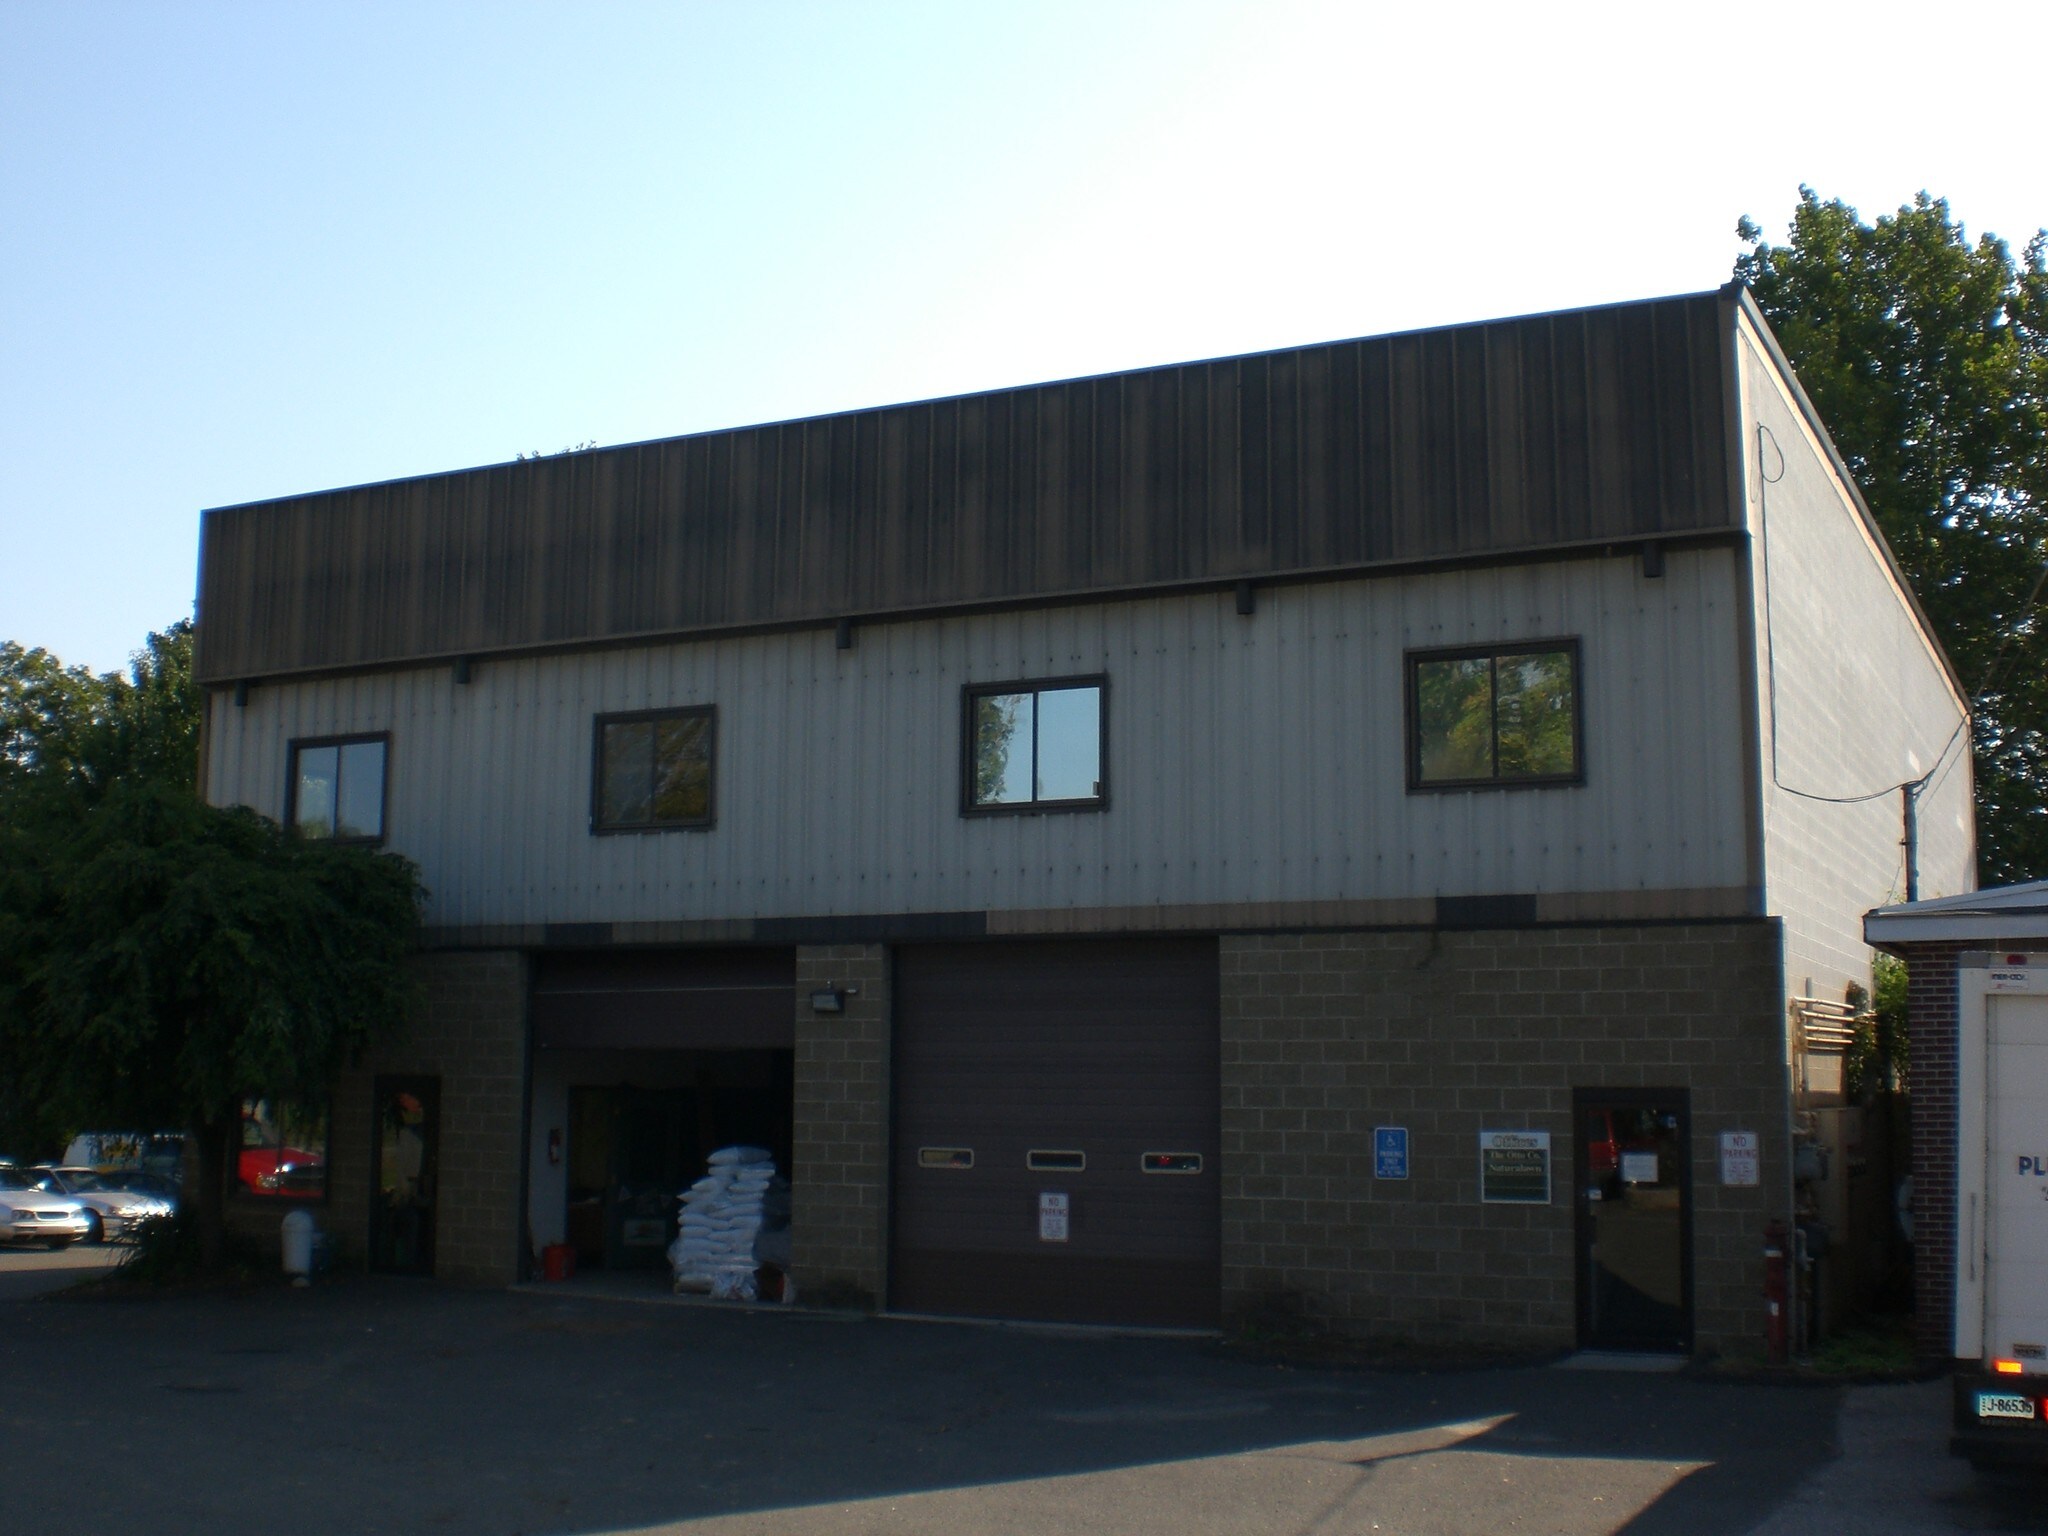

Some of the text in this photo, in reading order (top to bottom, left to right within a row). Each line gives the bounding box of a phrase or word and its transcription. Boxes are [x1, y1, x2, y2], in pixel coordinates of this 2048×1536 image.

[1733, 1137, 1746, 1147] NO
[1724, 1149, 1757, 1158] PARKING
[2018, 1155, 2048, 1176] PL
[1048, 1198, 1060, 1206] NO
[1040, 1208, 1069, 1216] PARKING
